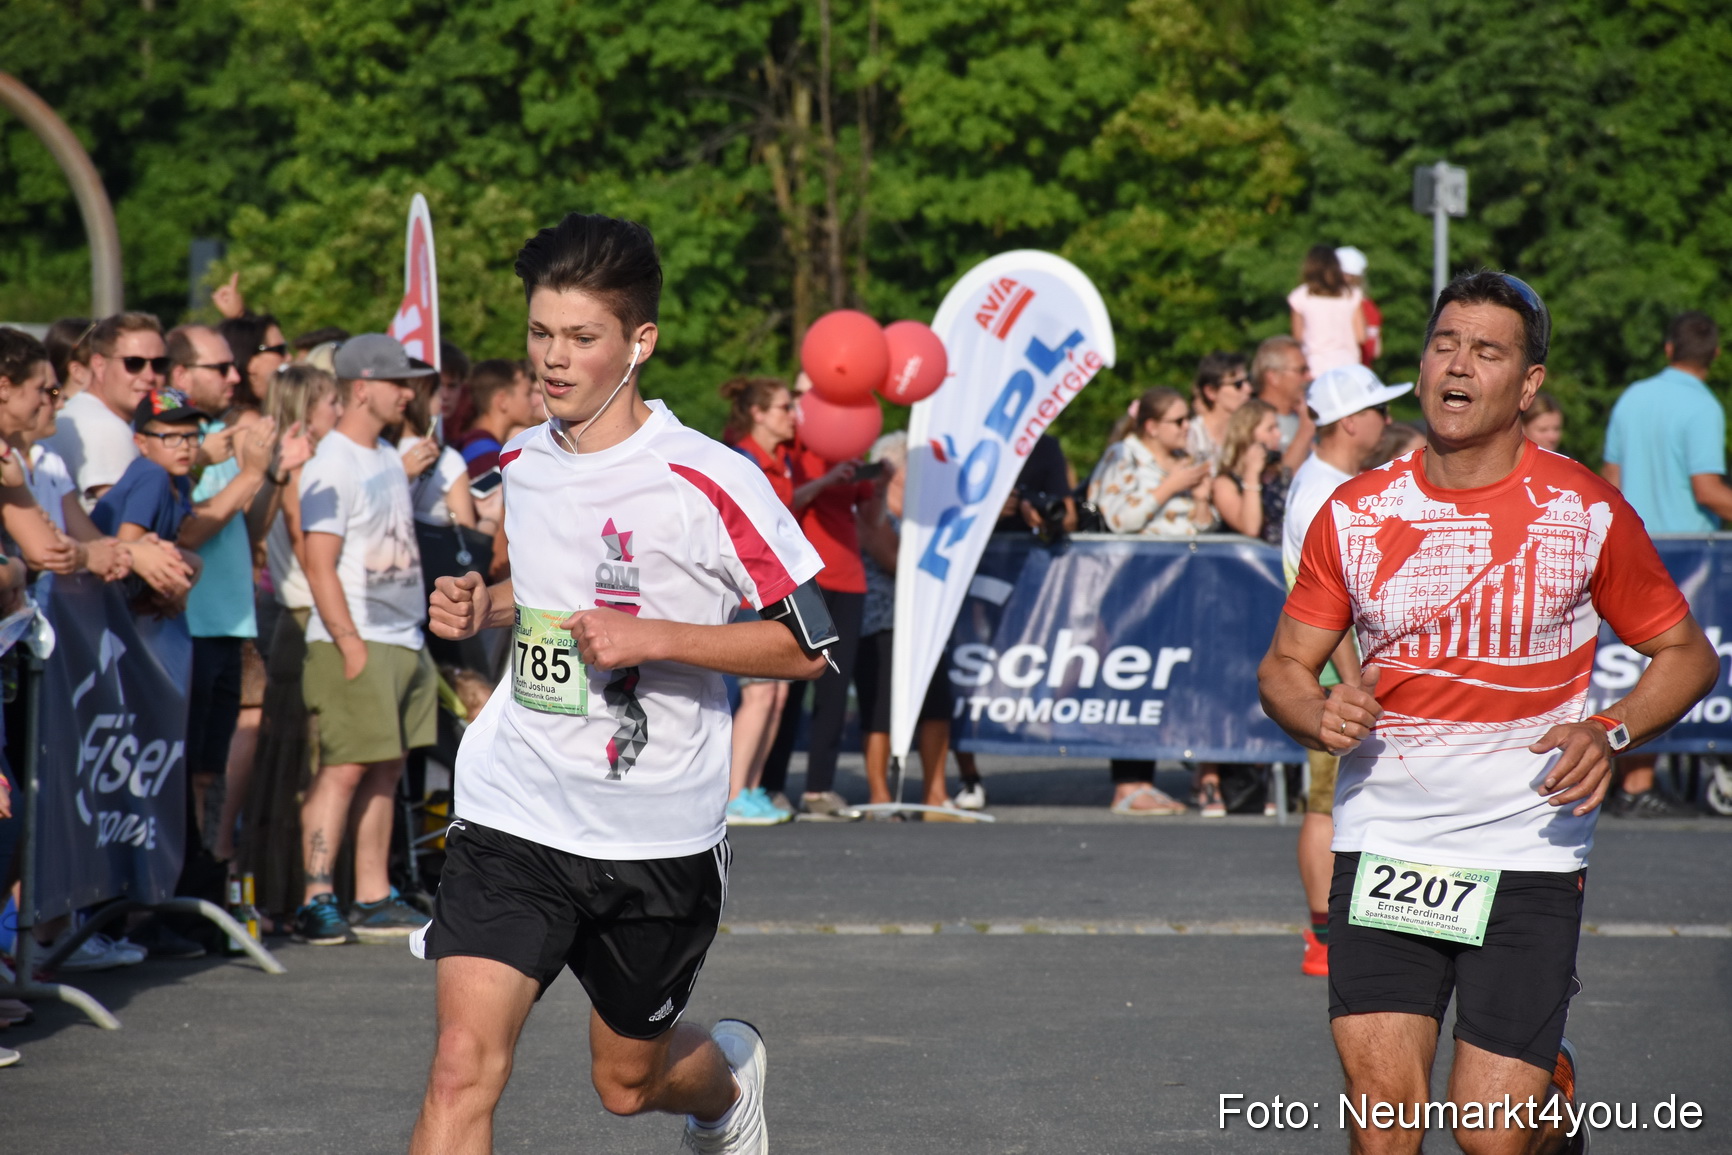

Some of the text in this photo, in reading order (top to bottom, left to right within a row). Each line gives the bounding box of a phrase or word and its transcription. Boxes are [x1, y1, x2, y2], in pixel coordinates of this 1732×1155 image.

[595, 562, 640, 588] OM
[1408, 584, 1449, 598] 26.22
[528, 680, 556, 694] Joshua
[1368, 864, 1477, 912] 2207
[1464, 872, 1490, 883] 2019
[1365, 909, 1399, 921] Sparkasse
[1400, 915, 1467, 934] Neumarkt-Parsberg
[1377, 901, 1459, 923] Ernst Ferdinand
